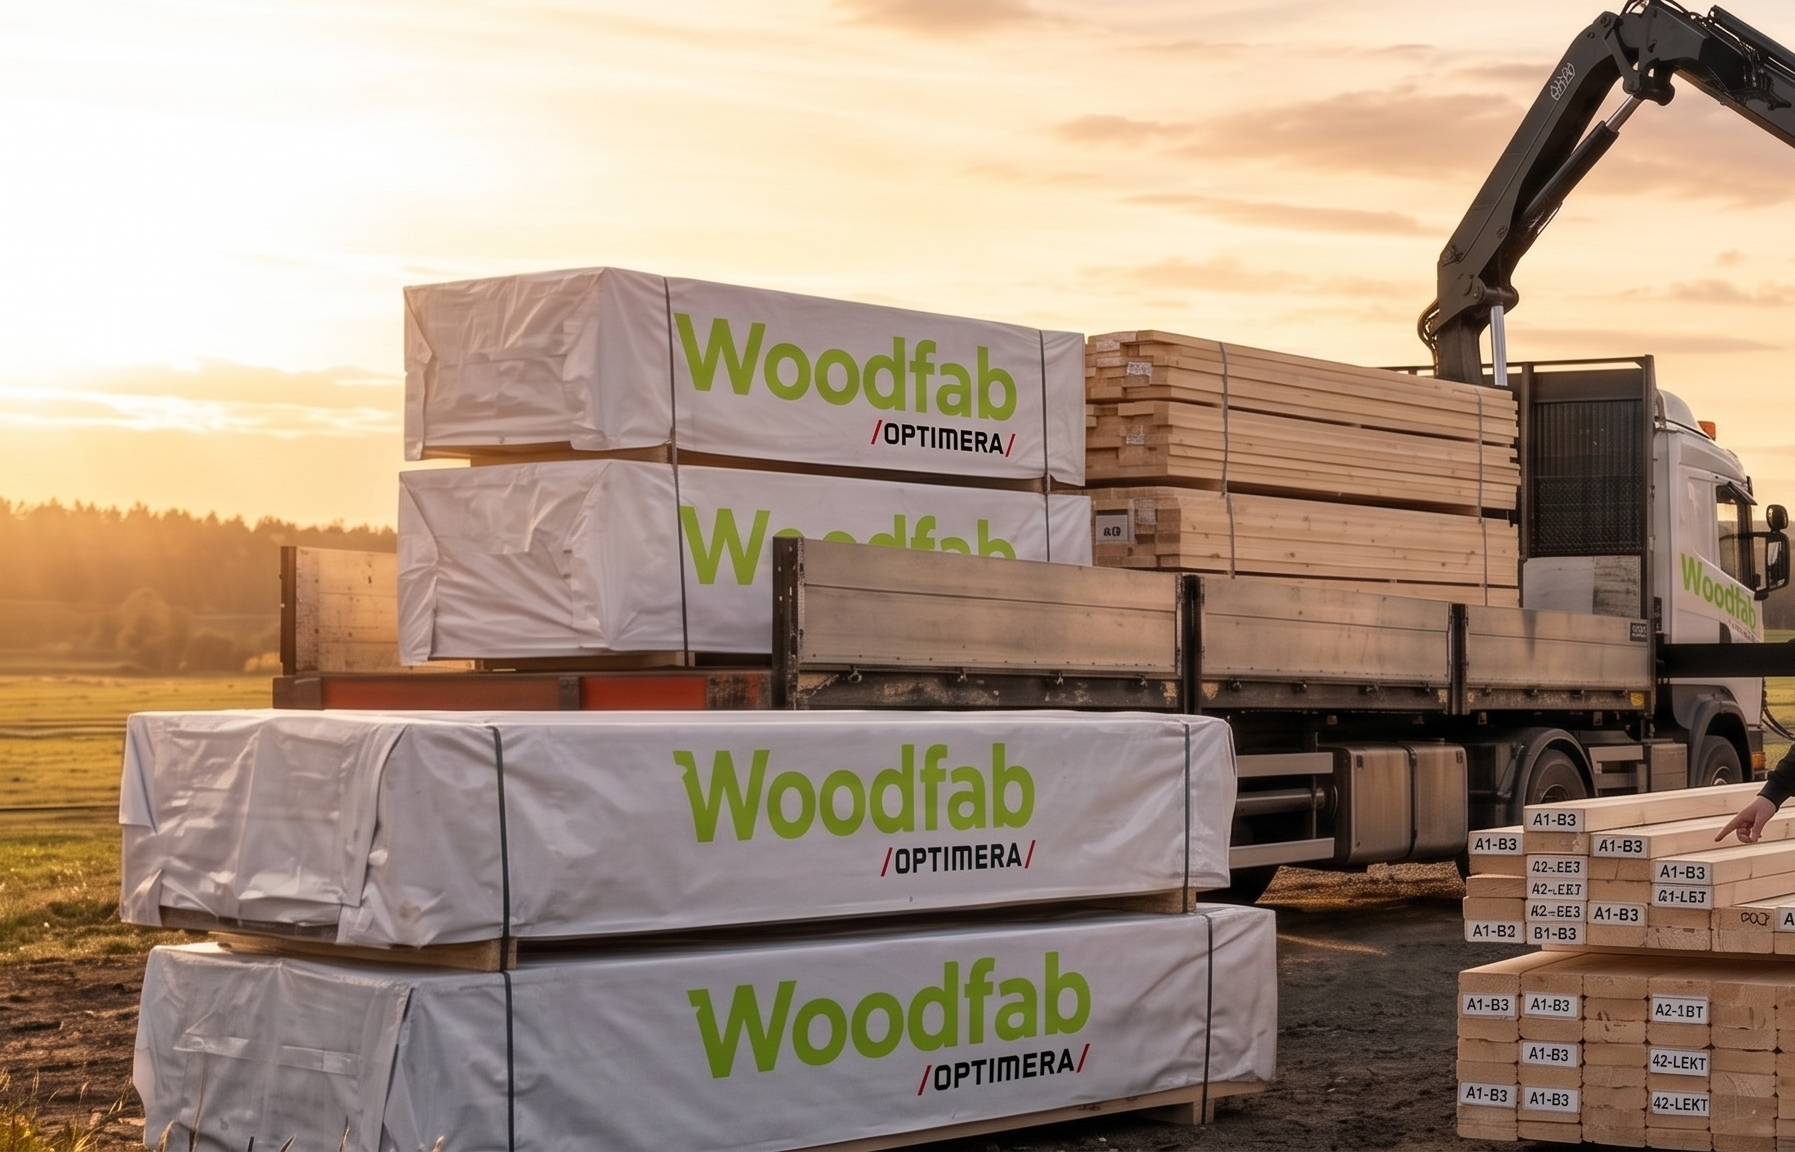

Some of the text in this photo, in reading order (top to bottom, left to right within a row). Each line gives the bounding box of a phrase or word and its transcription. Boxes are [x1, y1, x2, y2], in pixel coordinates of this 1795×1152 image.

[675, 313, 1017, 421] Woodfab
[1681, 553, 1756, 630] Woodfab
[673, 743, 1035, 843] Woodfab
[1533, 812, 1576, 827] A1-B3
[1474, 837, 1517, 851] A1-B3
[1599, 839, 1643, 853] A1-B3
[1660, 865, 1706, 880] A1-B3
[1594, 907, 1639, 922] A1-B3
[1473, 924, 1516, 938] A1-B2
[1534, 926, 1577, 940] B1-B3
[1467, 998, 1509, 1011] A1-B3
[1531, 998, 1570, 1012] A1-B3
[687, 951, 1091, 1079] Woodfab
[1529, 1046, 1569, 1062] A1-B3
[1652, 1054, 1707, 1071] 42-LEKT
[1466, 1086, 1508, 1102] A1-B3
[1530, 1091, 1569, 1107] A1-B3
[1653, 1097, 1708, 1112] 42-LEKT
